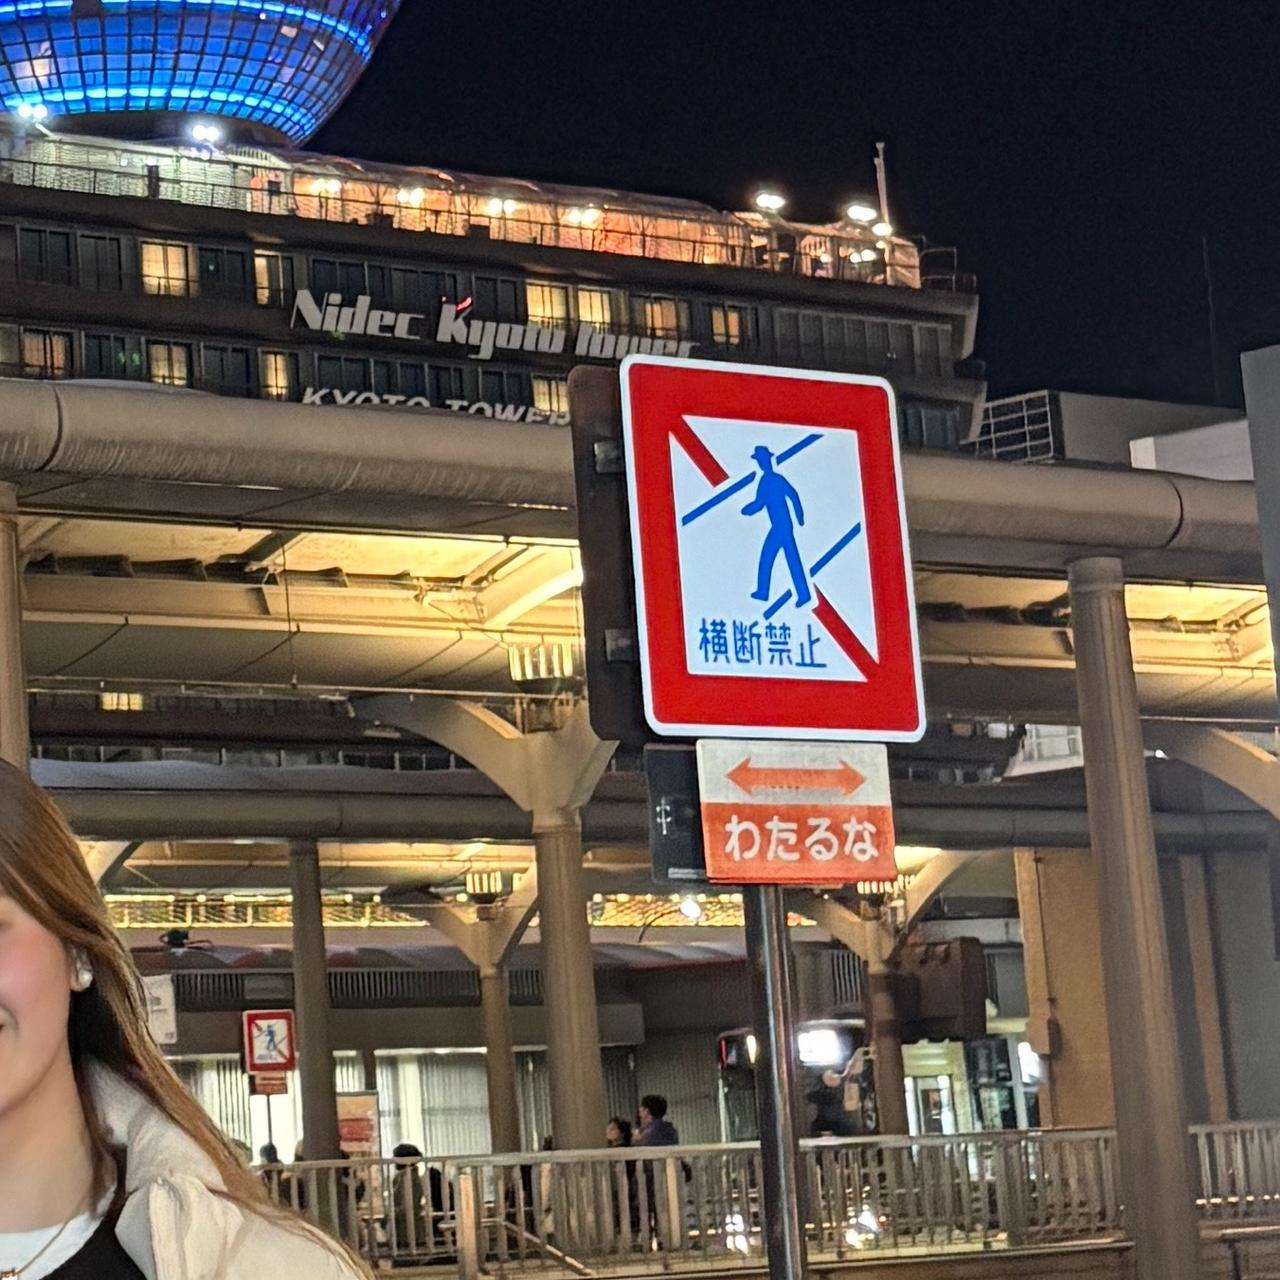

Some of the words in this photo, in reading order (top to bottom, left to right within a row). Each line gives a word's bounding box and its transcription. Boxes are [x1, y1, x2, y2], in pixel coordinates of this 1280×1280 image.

[290, 288, 424, 340] Nidec
[436, 297, 567, 360] Kyoto
[698, 616, 828, 669] 横断禁止
[724, 813, 880, 863] わたるな
